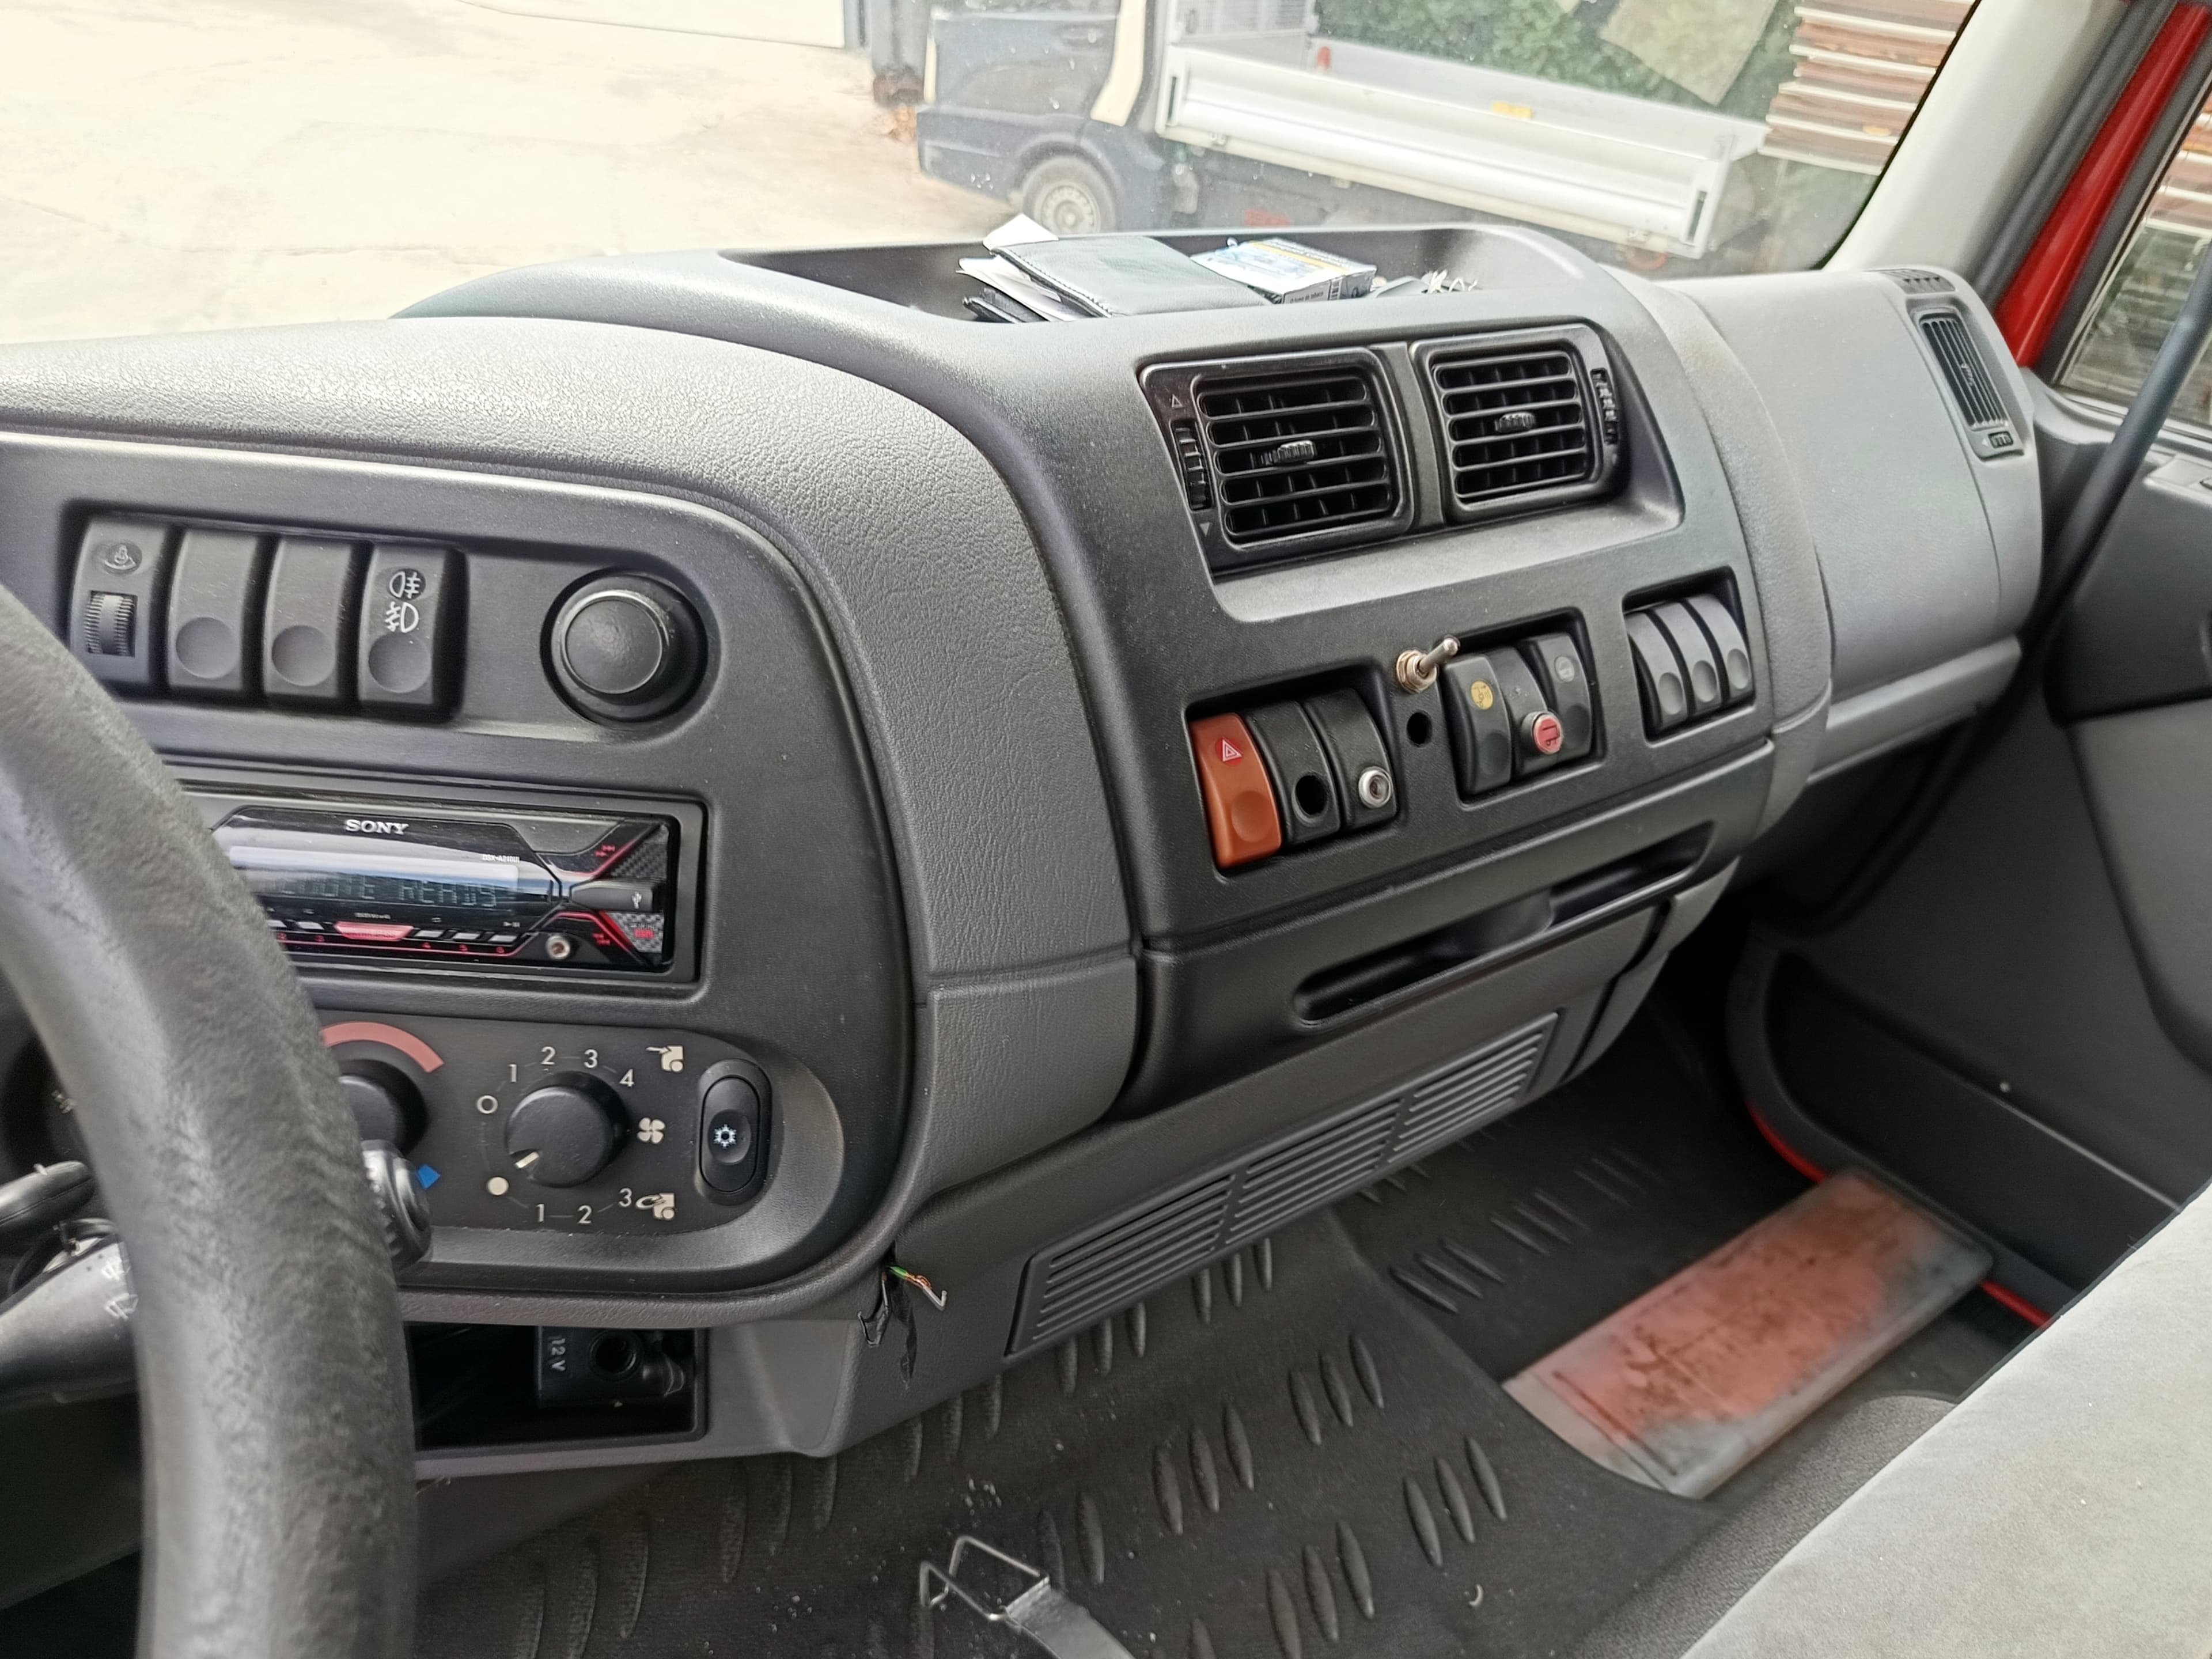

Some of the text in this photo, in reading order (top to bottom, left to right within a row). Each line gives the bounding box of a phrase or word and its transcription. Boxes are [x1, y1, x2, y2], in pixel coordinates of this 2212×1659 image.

[345, 819, 409, 835] SONY
[509, 1064, 517, 1083] 1
[540, 1047, 556, 1065] 2
[584, 1049, 598, 1068] 3
[619, 1069, 635, 1087] 4
[536, 1187, 632, 1224] 1 2 3
